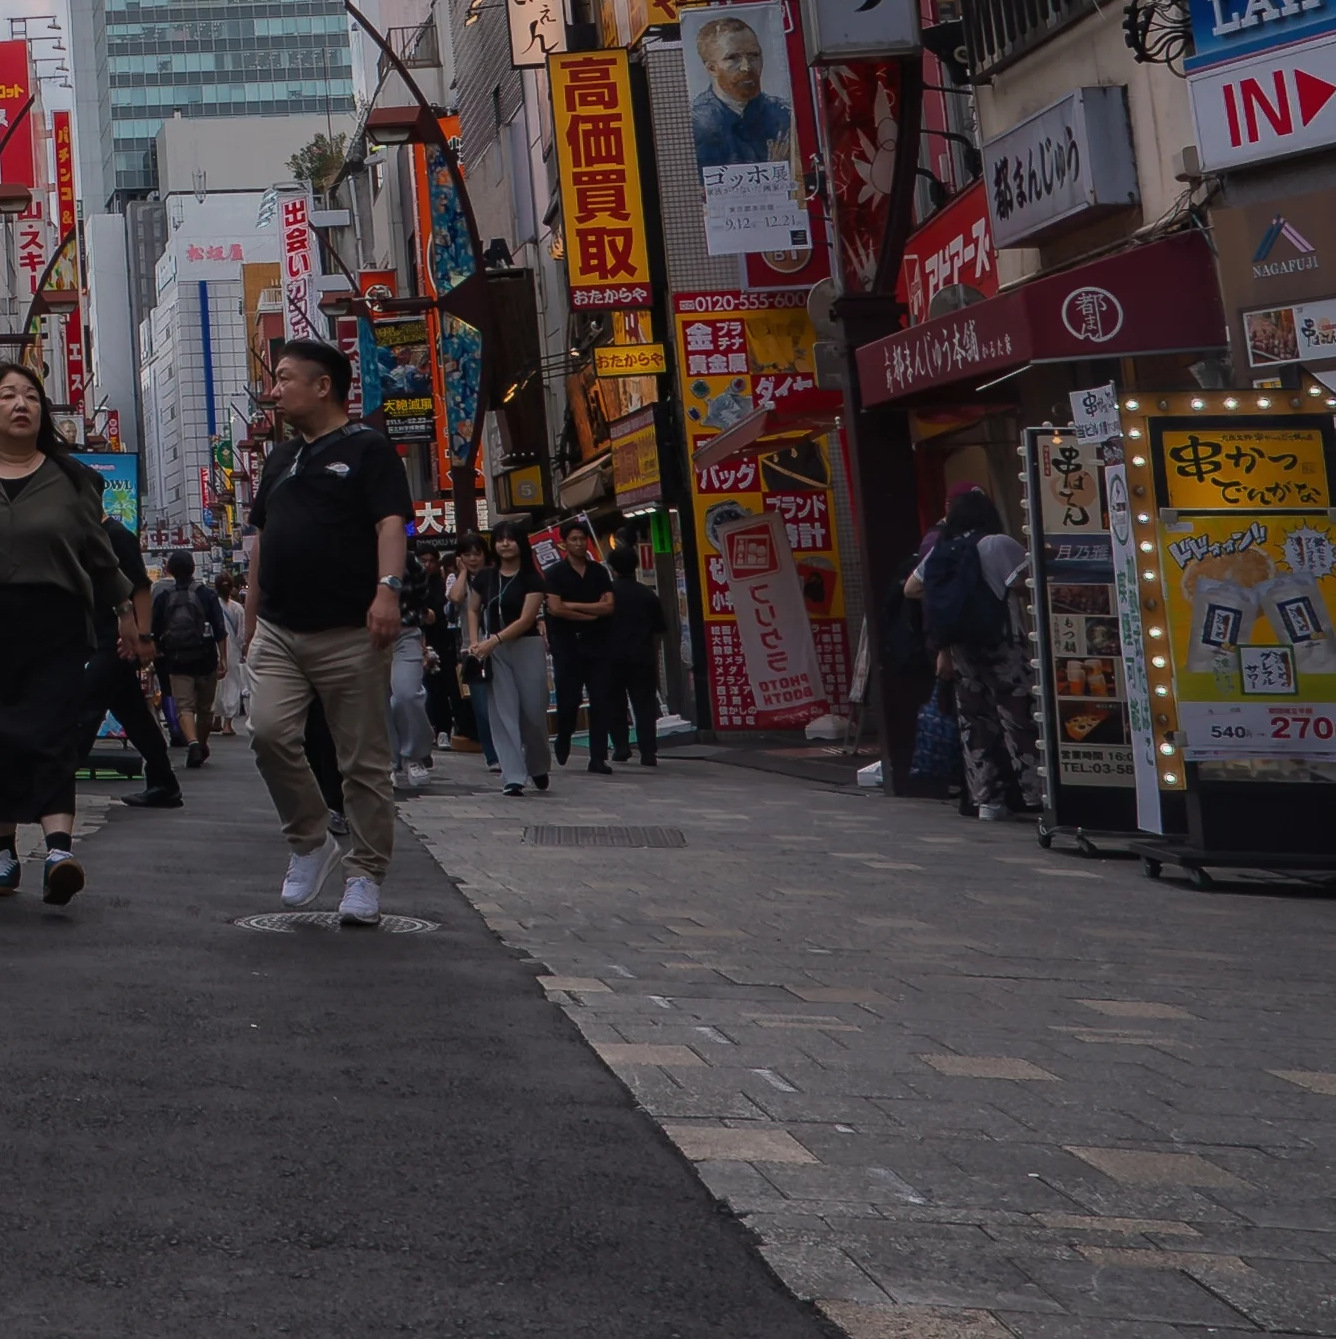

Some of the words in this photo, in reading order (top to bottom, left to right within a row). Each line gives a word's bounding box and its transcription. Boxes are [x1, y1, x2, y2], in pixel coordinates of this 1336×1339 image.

[1222, 69, 1293, 148] IN
[559, 57, 637, 279] 高価買取
[705, 164, 788, 188] ゴッホ展
[993, 125, 1081, 221] 都まんじゅう
[925, 216, 990, 301] アドアーズ
[1252, 256, 1319, 279] NAGAFUJI
[573, 287, 648, 306] おたからや
[685, 323, 714, 351] 金
[596, 352, 664, 369] おたからや
[1169, 435, 1298, 483] 串かつ
[700, 463, 756, 490] バッグ
[1211, 476, 1322, 505] でんがな
[766, 494, 826, 519] ブランド
[1270, 716, 1334, 739] 270
